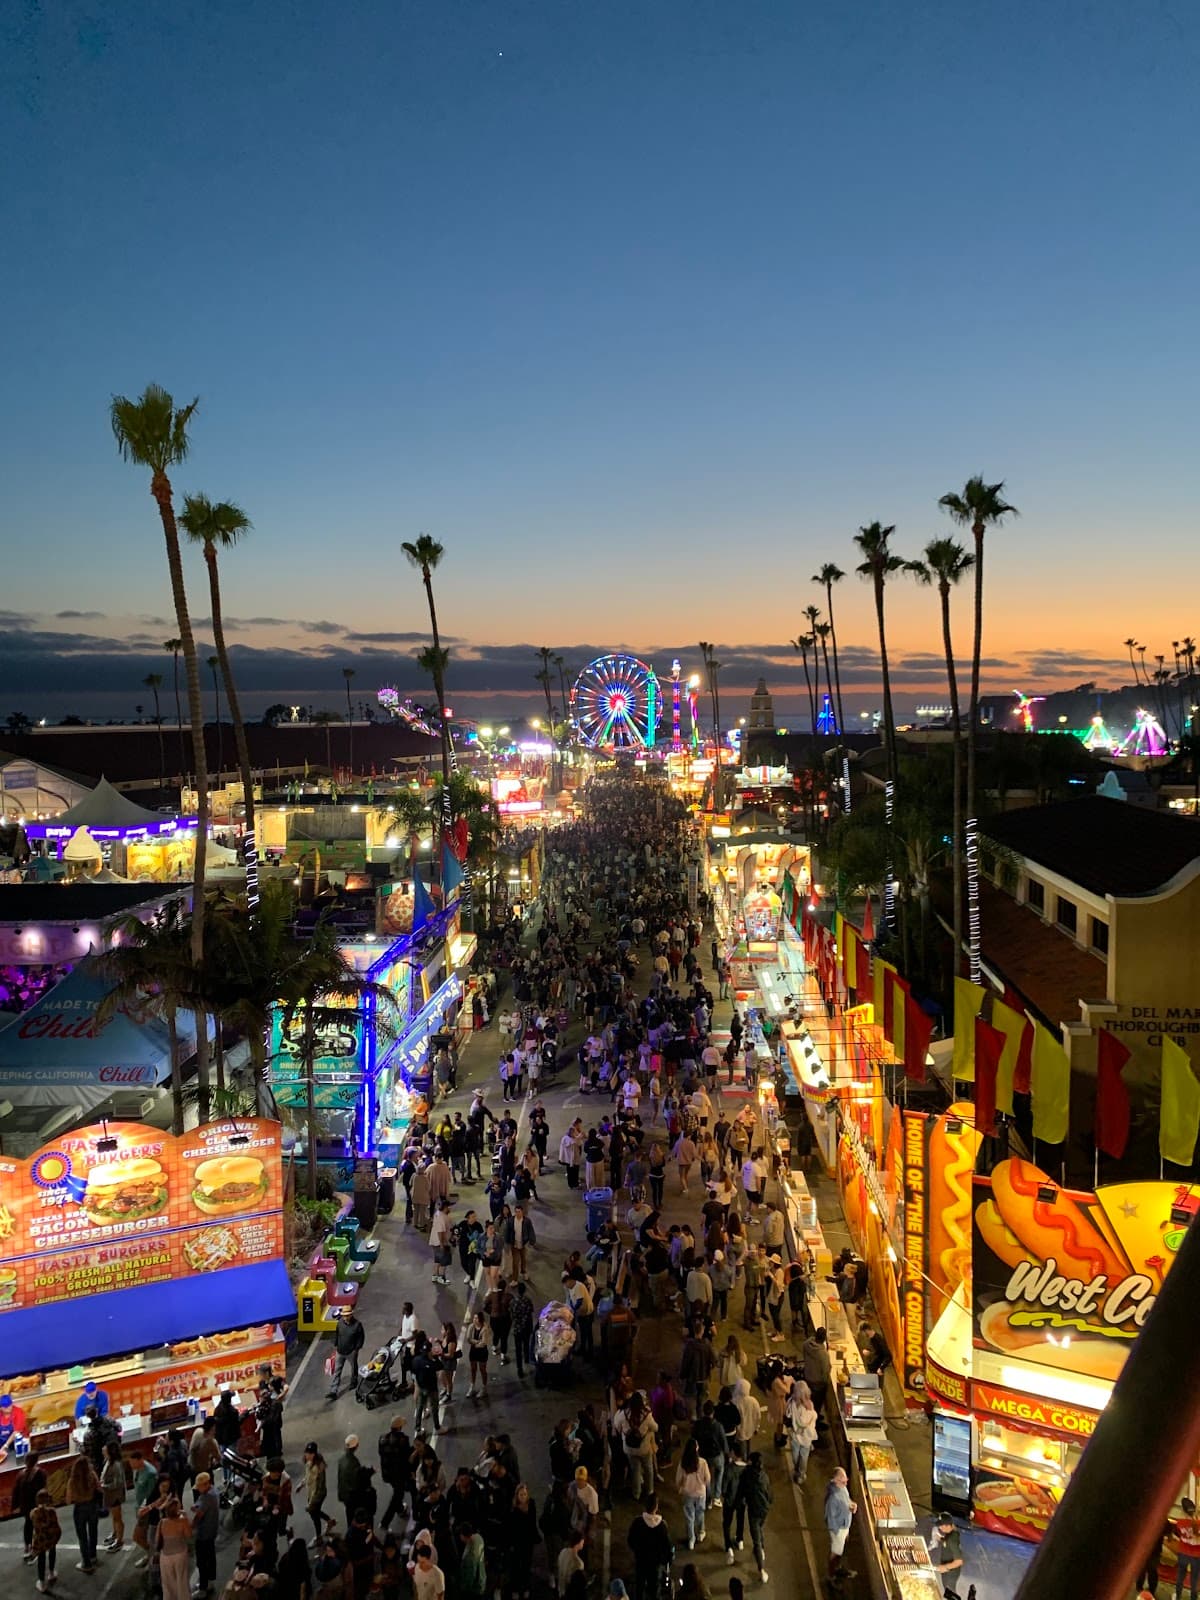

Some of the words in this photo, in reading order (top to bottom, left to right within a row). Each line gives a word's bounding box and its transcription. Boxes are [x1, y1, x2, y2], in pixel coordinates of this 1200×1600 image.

[43, 1000, 82, 1010] MADE
[1132, 1007, 1160, 1018] DEL
[34, 1071, 94, 1081] CALIFORNIA
[99, 1066, 147, 1082] Chill
[198, 1122, 259, 1139] ORIGINAL
[905, 1117, 924, 1167] HOME
[83, 1142, 163, 1168] BURGERS
[905, 1168, 924, 1192] OF
[29, 1217, 90, 1237] BACON
[34, 1215, 170, 1249] CHEESEBURGER
[96, 1239, 168, 1265] BURGERS
[33, 1273, 65, 1288] 100%
[68, 1266, 100, 1282] FRESH
[104, 1263, 122, 1274] ALL
[125, 1253, 173, 1270] NATURAL
[66, 1274, 113, 1292] GROUND
[116, 1269, 141, 1284] BEEF
[1005, 1258, 1108, 1314] West
[905, 1291, 924, 1367] CORNDOG
[990, 1398, 1046, 1423] MEGA
